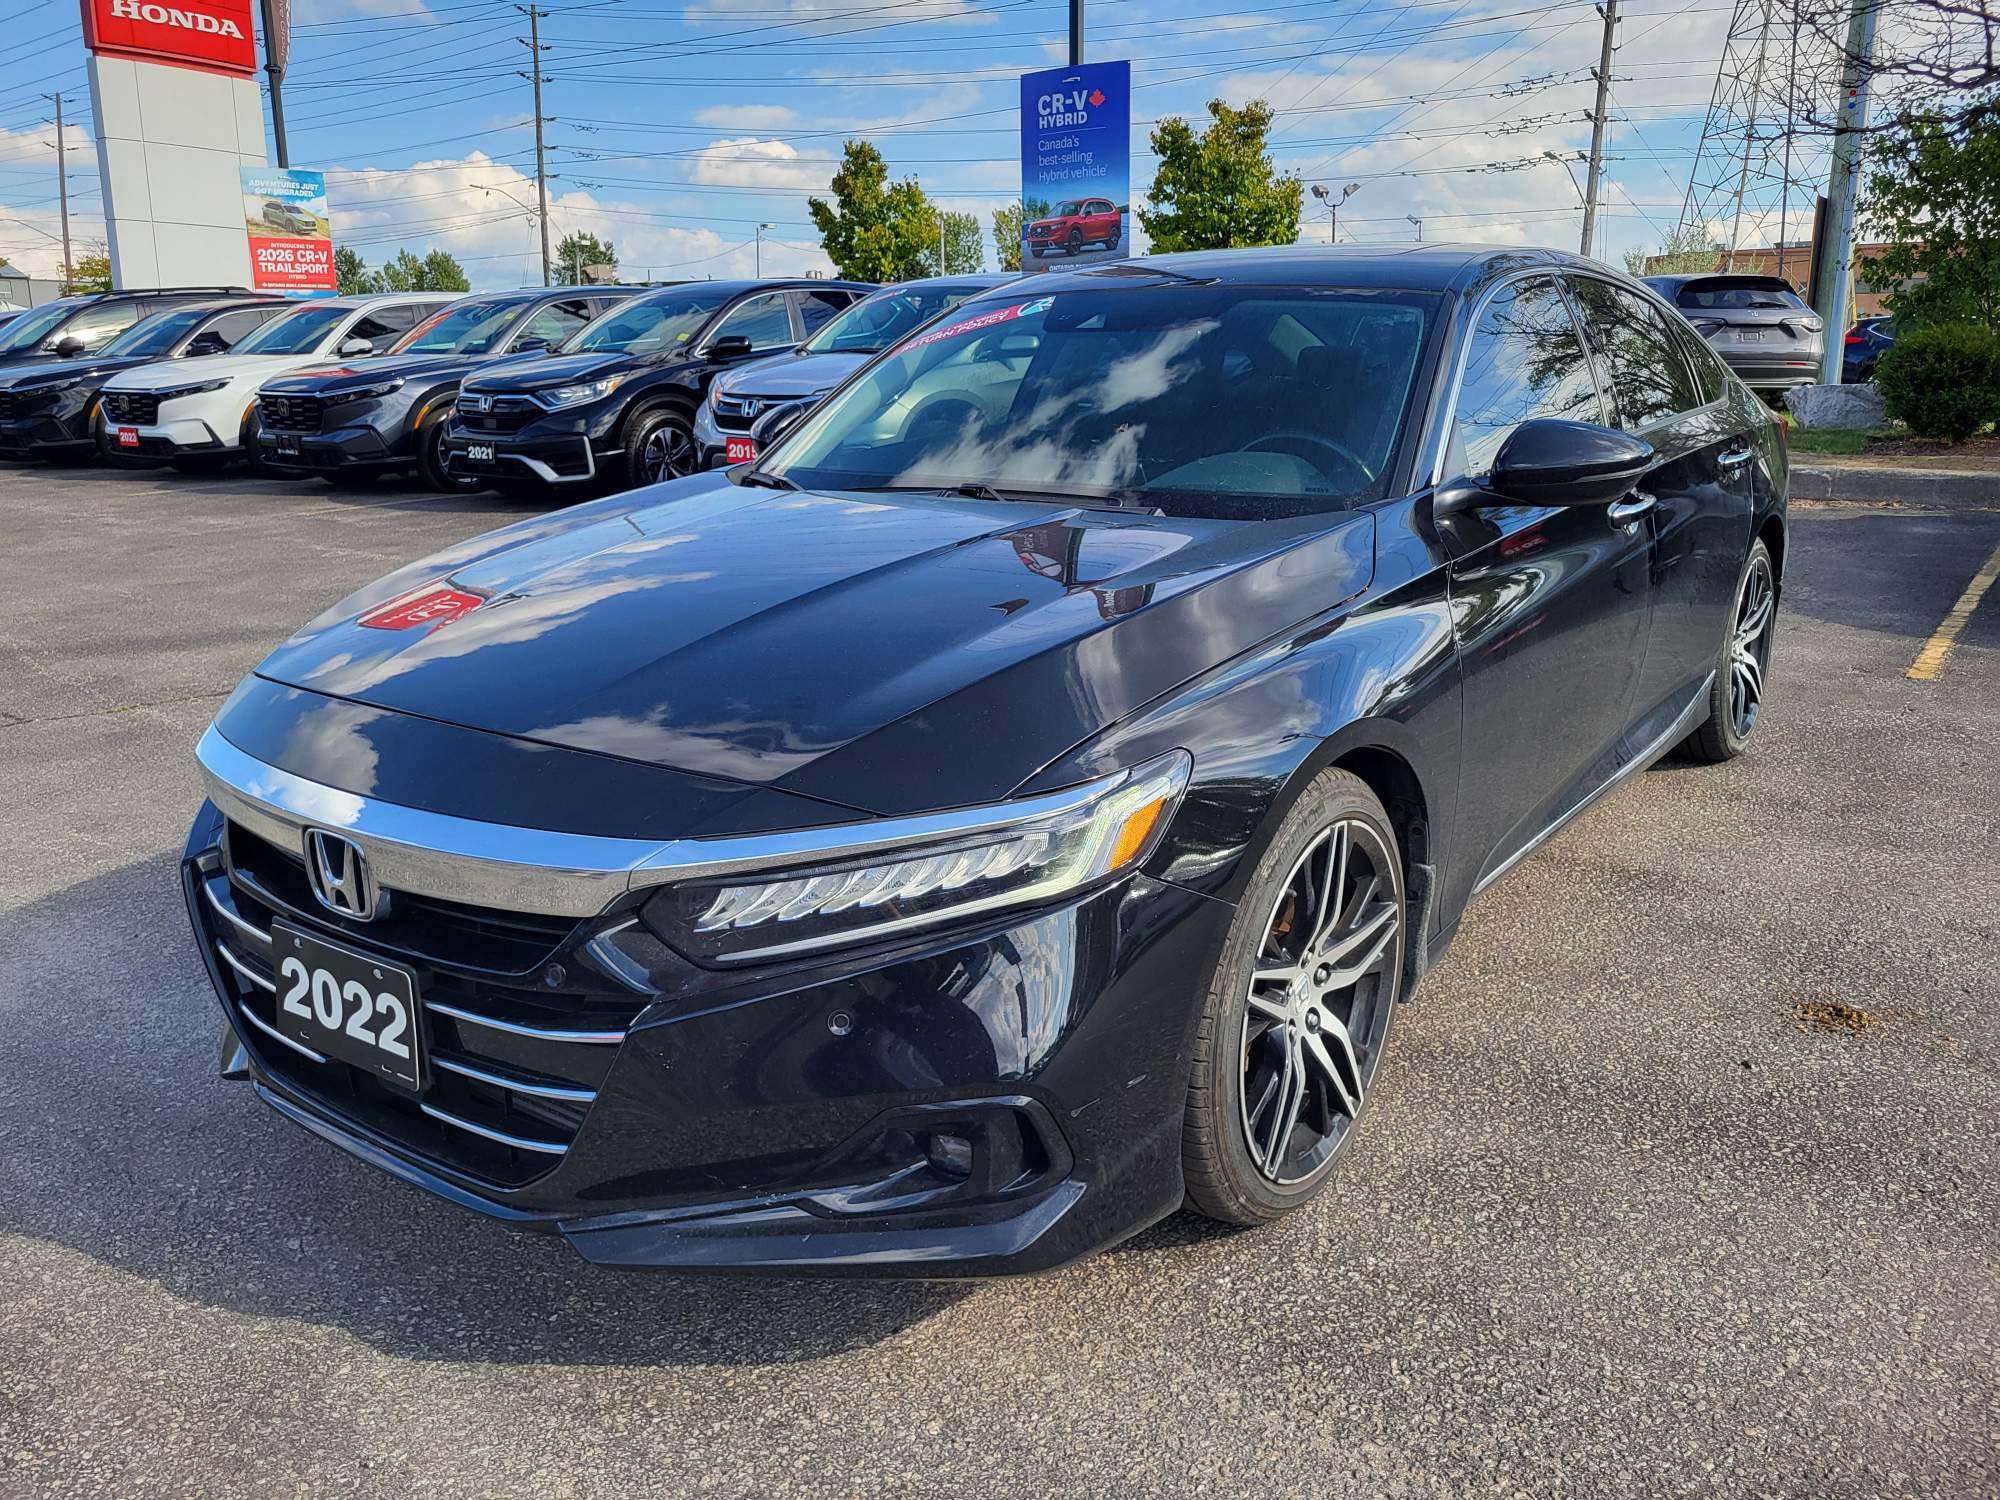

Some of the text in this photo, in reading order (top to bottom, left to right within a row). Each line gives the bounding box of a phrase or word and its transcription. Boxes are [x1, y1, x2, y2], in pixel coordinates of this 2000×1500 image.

[111, 0, 245, 40] HONDA
[1037, 89, 1089, 116] CR-V
[1039, 111, 1088, 129] HYBRID
[1038, 135, 1080, 151] Canada's
[1039, 150, 1093, 166] best-selling
[1039, 168, 1069, 184] Hybrid
[248, 179, 300, 190] ADVENTURES
[256, 248, 328, 263] 2026 CR-V
[258, 262, 329, 274] TRAILSPORT
[467, 446, 493, 460] 2021
[281, 956, 410, 1060] 2022
